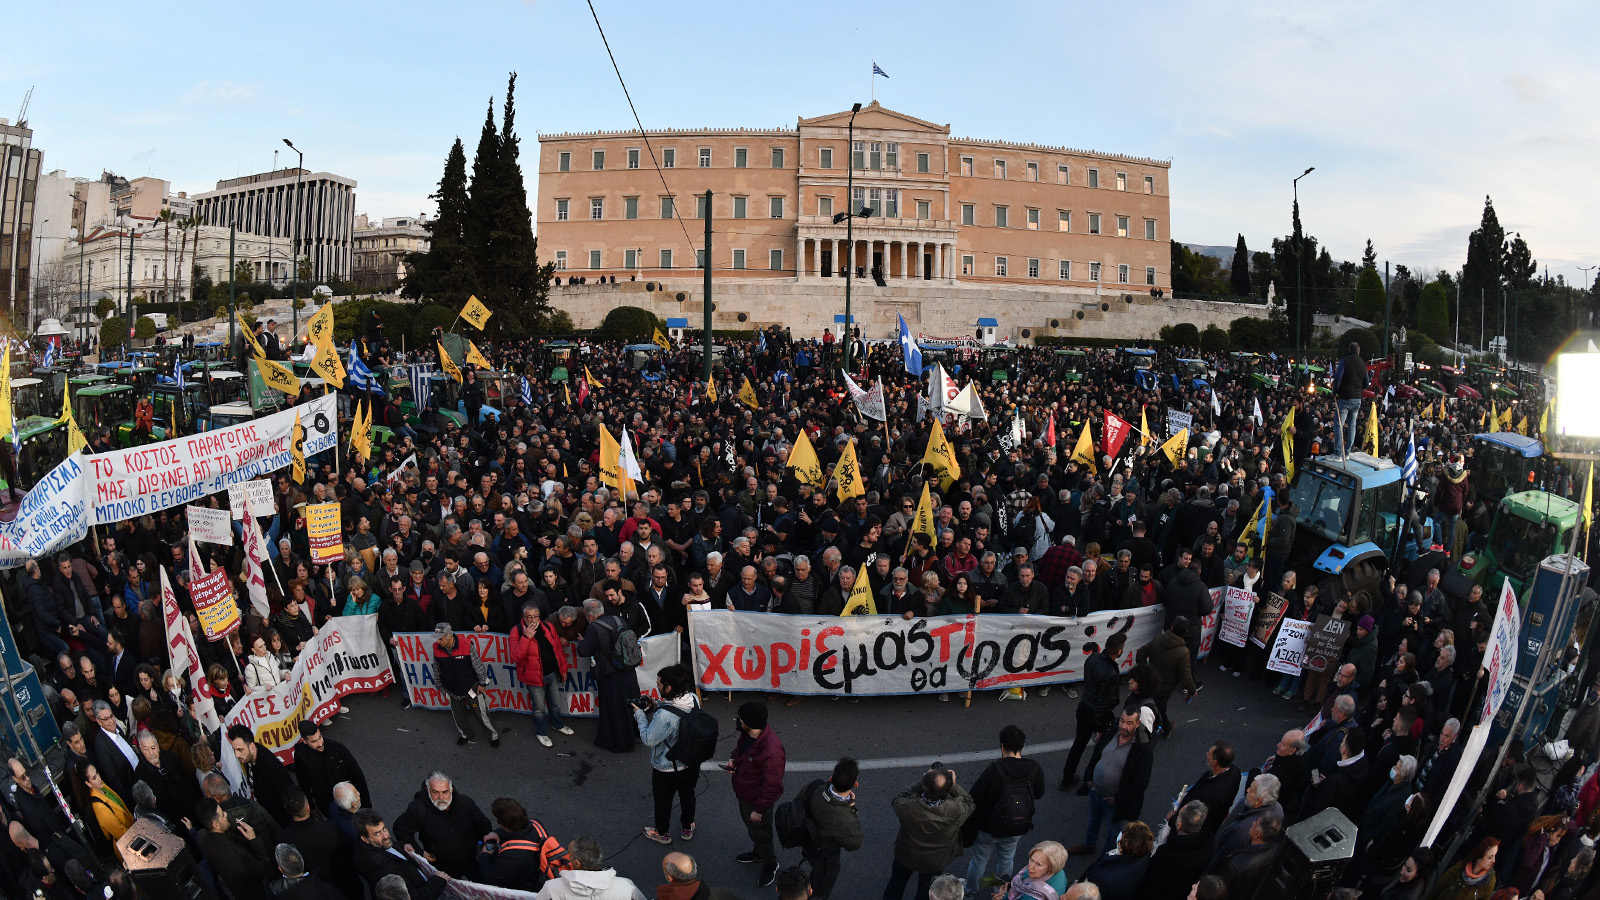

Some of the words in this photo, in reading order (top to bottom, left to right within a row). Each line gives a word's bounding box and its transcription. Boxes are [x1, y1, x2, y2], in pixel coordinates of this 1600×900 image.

[90, 457, 114, 480] ΤΟ
[124, 444, 181, 473] ΚΟΣΤΟΣ
[187, 425, 261, 459] ΠΑΡΑΓΩΓΗΣ
[95, 497, 146, 522] ΜΠΛΟΚΟ
[306, 431, 337, 454] ΕΥΒΟΙΑΣ
[97, 479, 127, 504] ΜΑΣ
[138, 466, 190, 495] ΔΙΩΧΝΕΙ
[213, 455, 234, 475] ΤΑ
[235, 444, 265, 468] ΧΩΡΙΑ
[266, 435, 288, 457] ΜΑΣ
[19, 457, 82, 523] ΕΚΛΗΡΙΣΜΑ
[192, 571, 224, 592] Απαιτούμε
[194, 588, 213, 602] μέτρα
[213, 578, 226, 592] κατά
[1227, 588, 1253, 602] ΑΥΞΗΣΗ
[1322, 619, 1346, 635] ΔΕΝ
[398, 635, 430, 662] ΝΑ
[1274, 648, 1302, 664] ΑΞΙΖΕΙ
[326, 651, 380, 679] πιβίωση
[404, 662, 419, 685] Η
[413, 687, 451, 706] ΑΓΡΟ
[312, 701, 338, 725] ΚΩΝ
